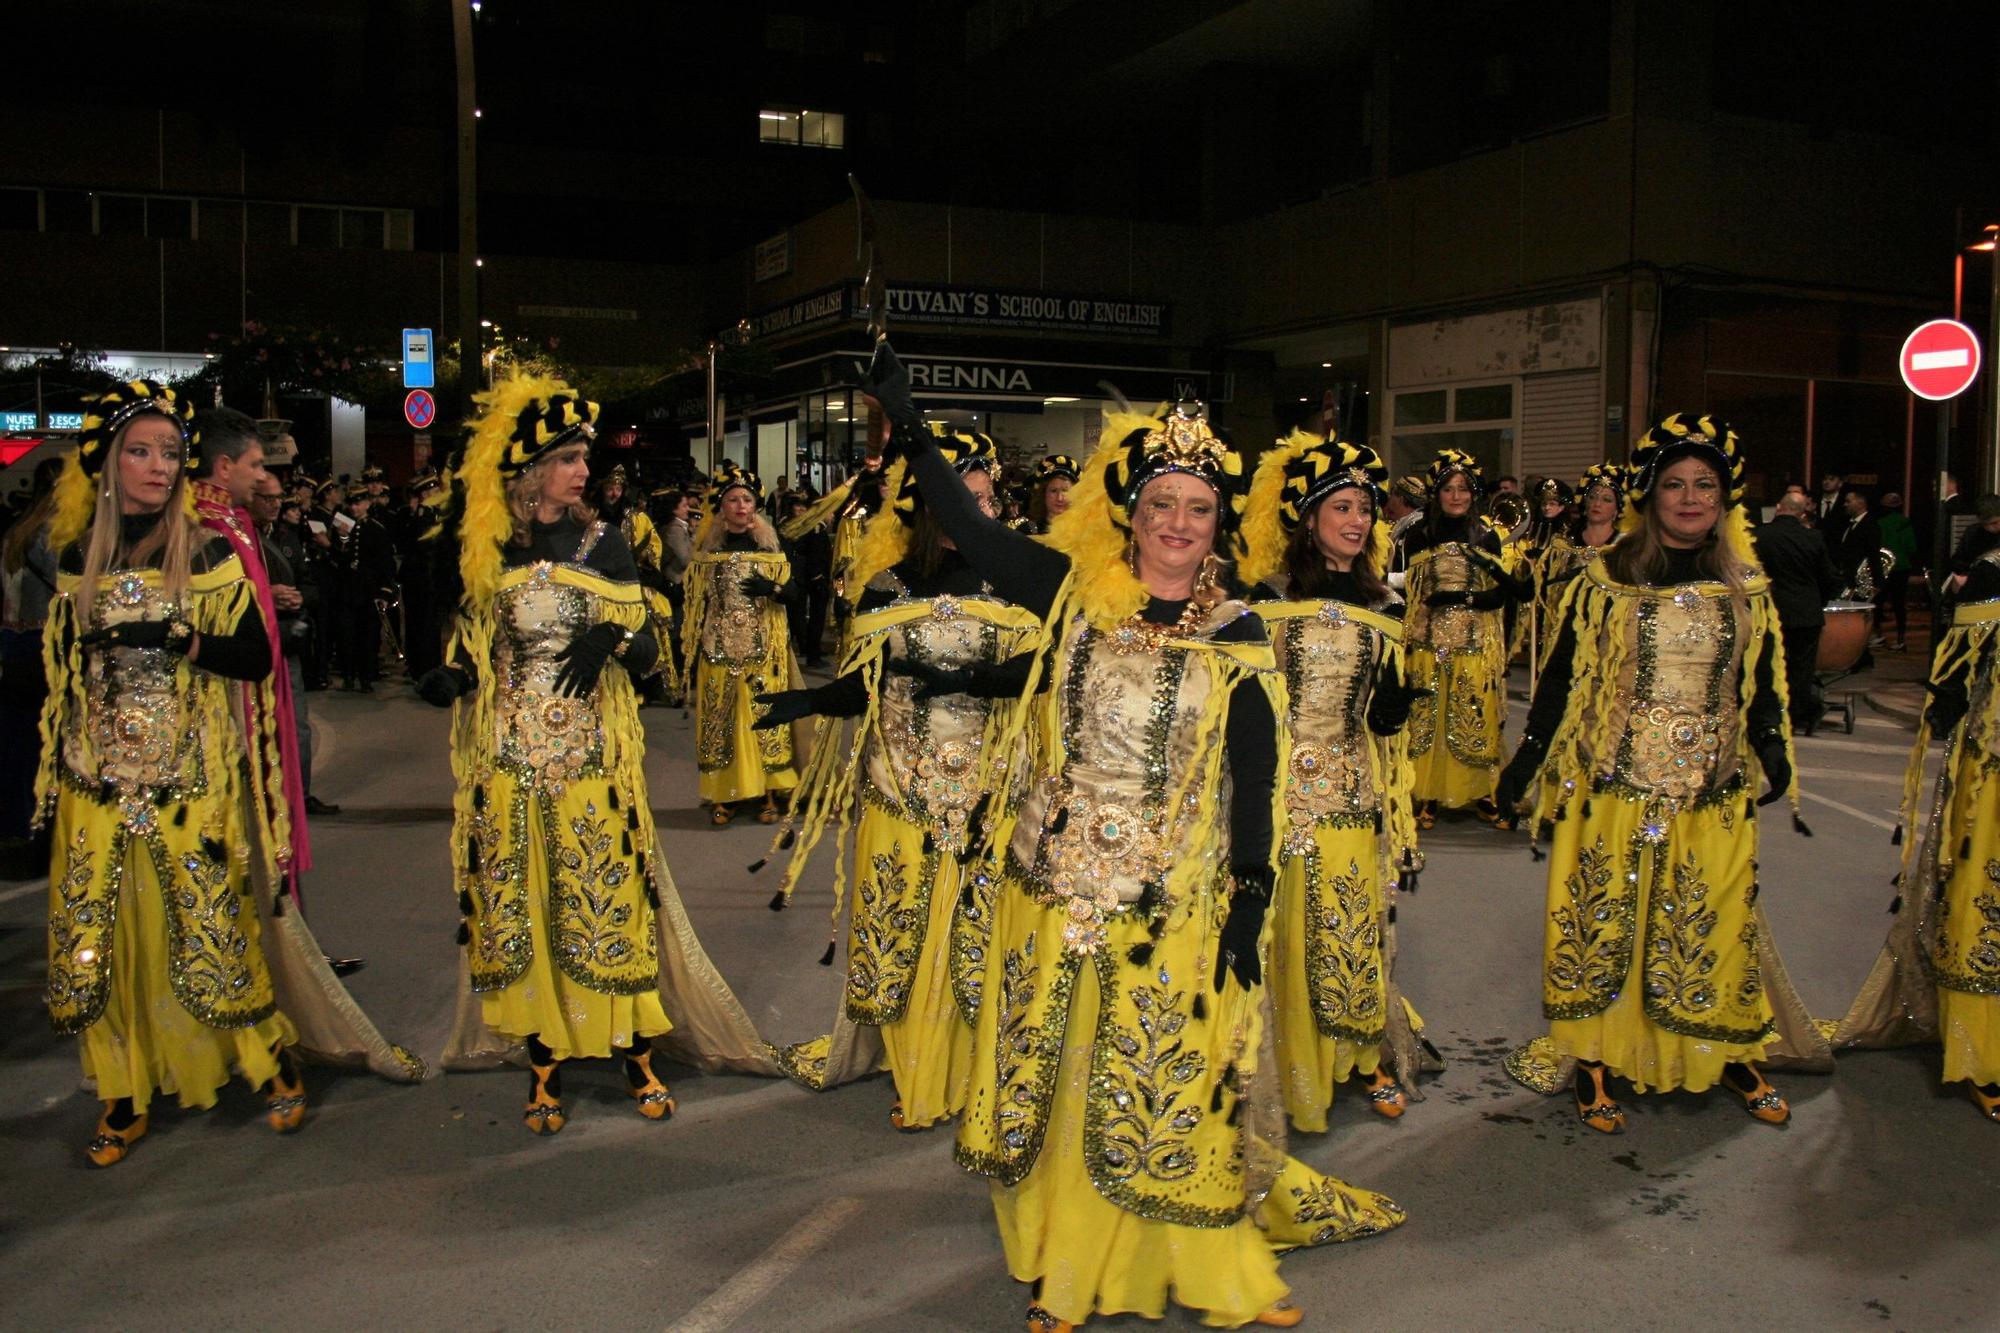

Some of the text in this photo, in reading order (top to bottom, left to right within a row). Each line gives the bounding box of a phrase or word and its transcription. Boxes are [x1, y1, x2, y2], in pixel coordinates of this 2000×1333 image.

[792, 303, 803, 325] OF
[1068, 299, 1090, 321] OF
[853, 360, 1033, 391] VRENNA
[57, 415, 82, 426] ESCA
